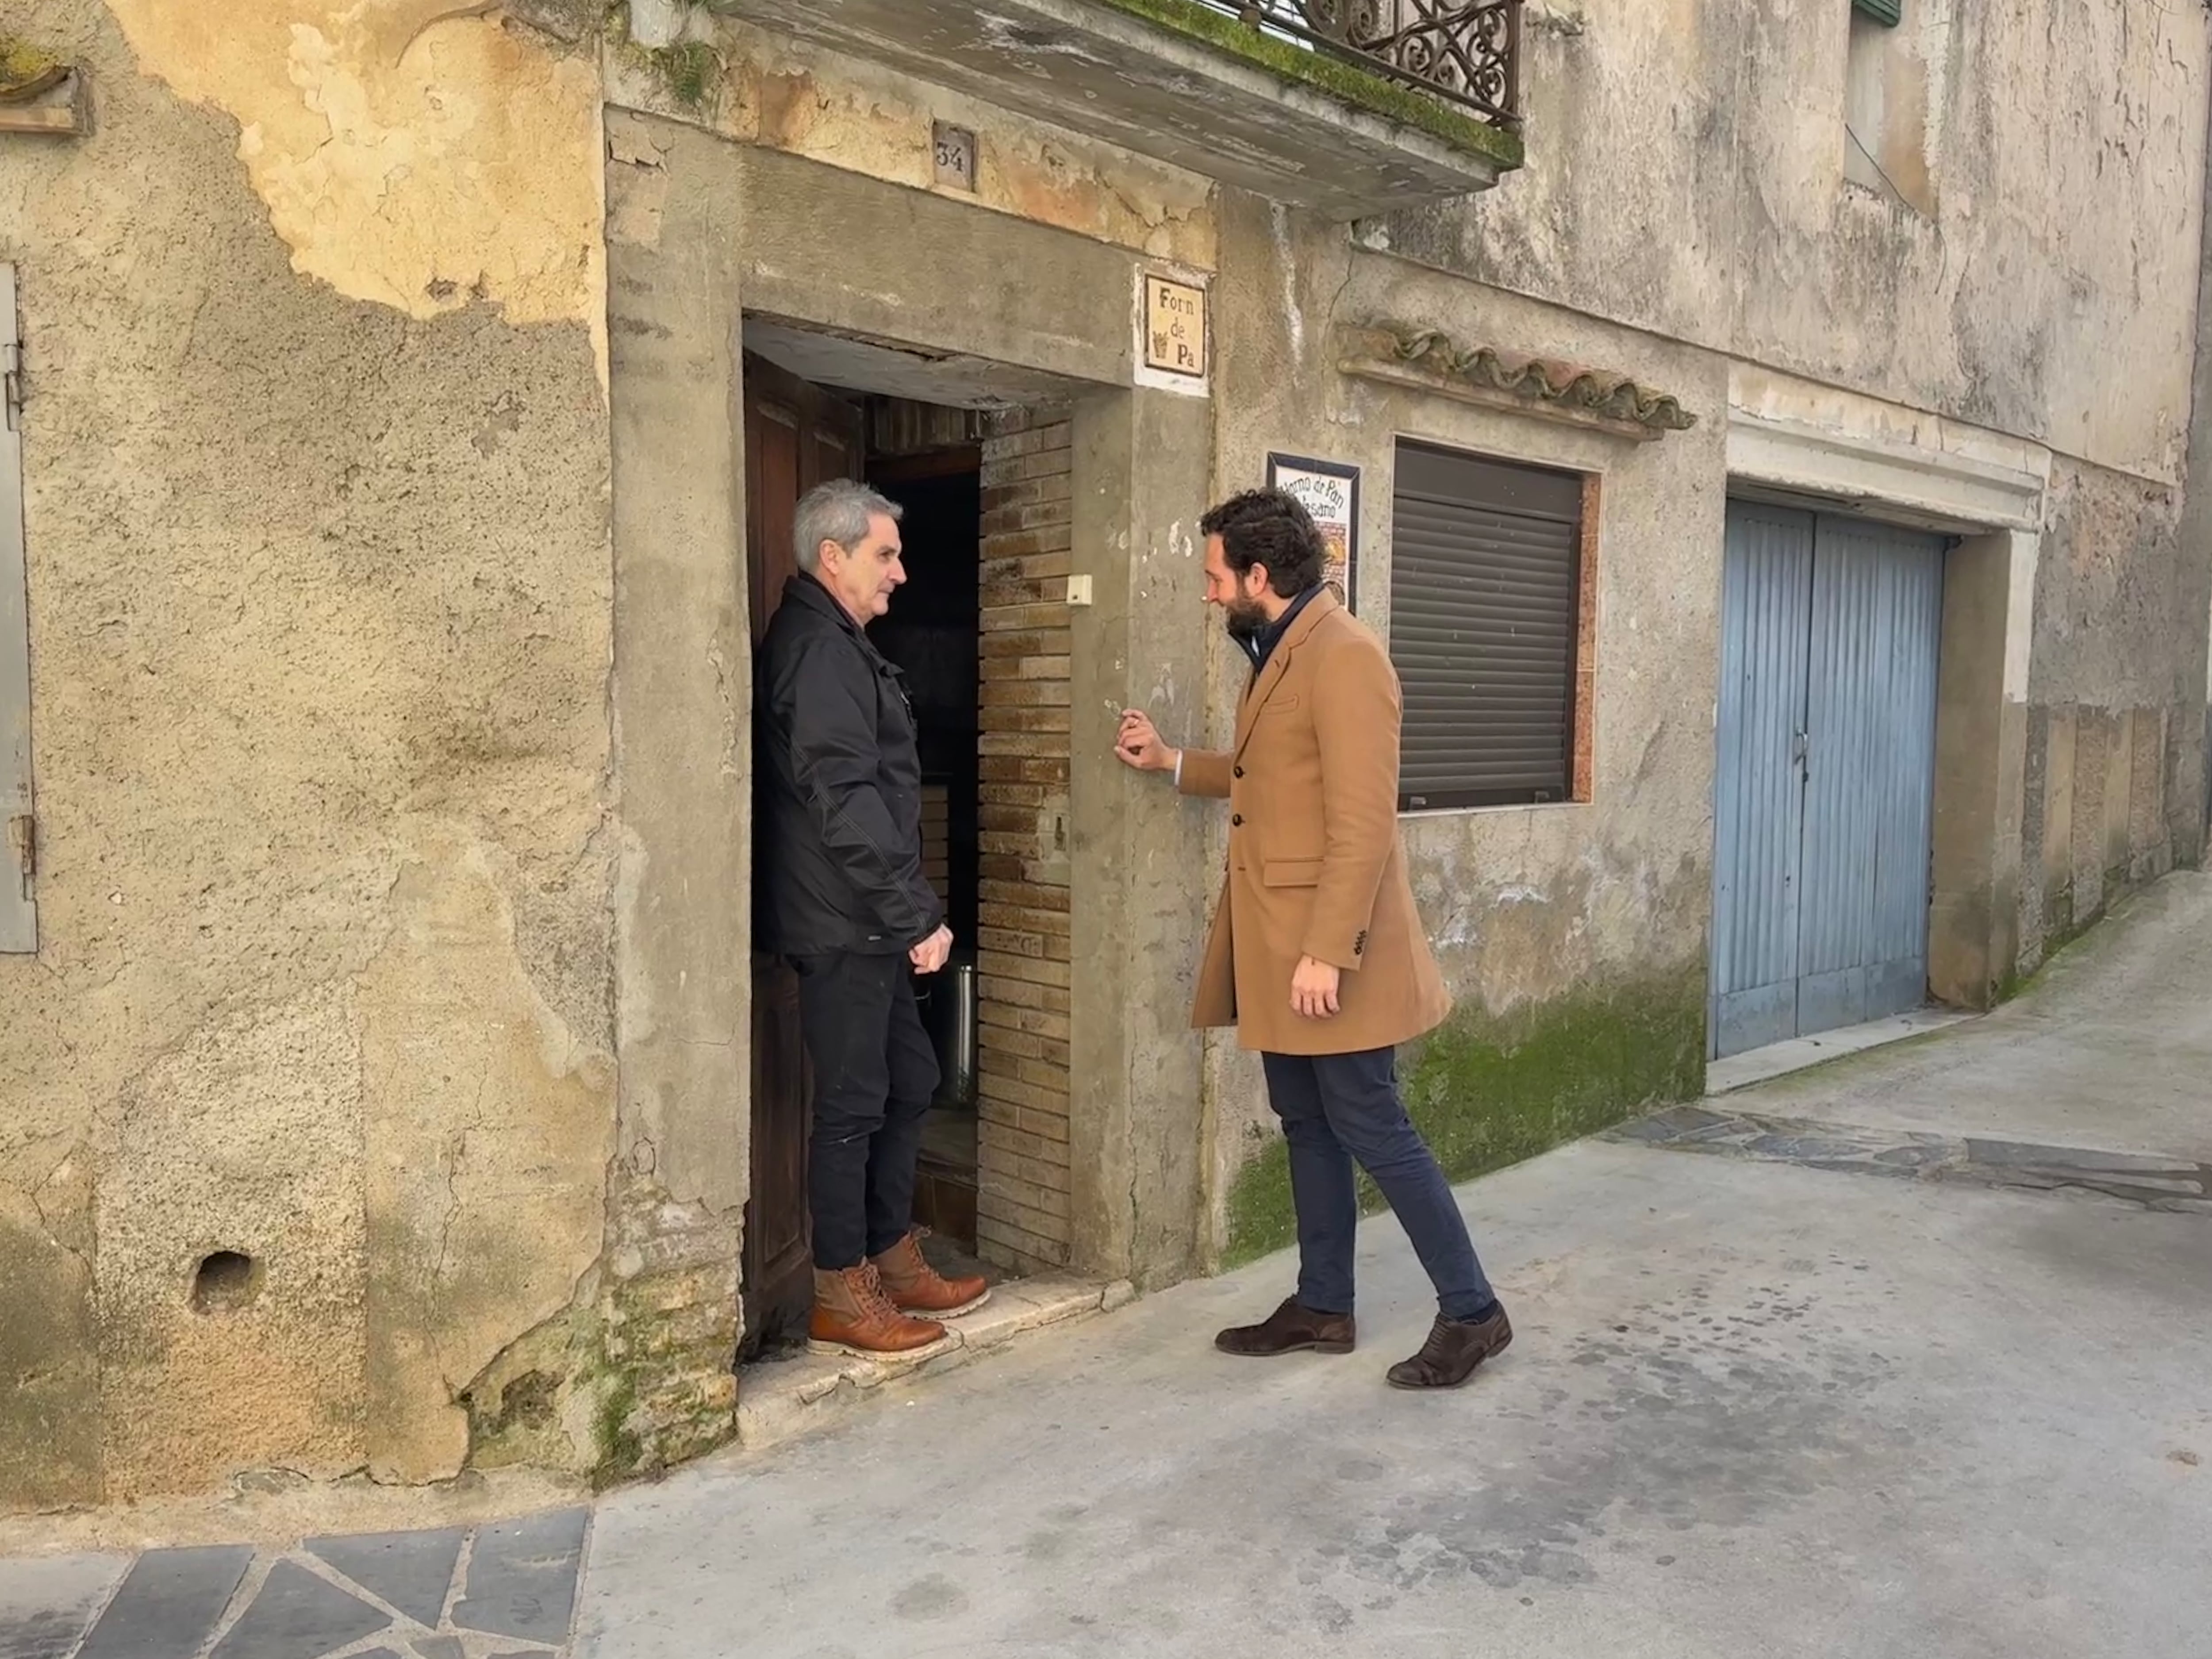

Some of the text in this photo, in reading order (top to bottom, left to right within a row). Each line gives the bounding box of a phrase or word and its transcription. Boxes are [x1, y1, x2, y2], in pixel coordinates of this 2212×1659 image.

[936, 141, 963, 172] 34
[1159, 286, 1194, 315] Forn
[1170, 317, 1185, 339] de
[1177, 344, 1194, 368] Pa
[1313, 476, 1325, 495] de
[1326, 480, 1344, 509] Pan
